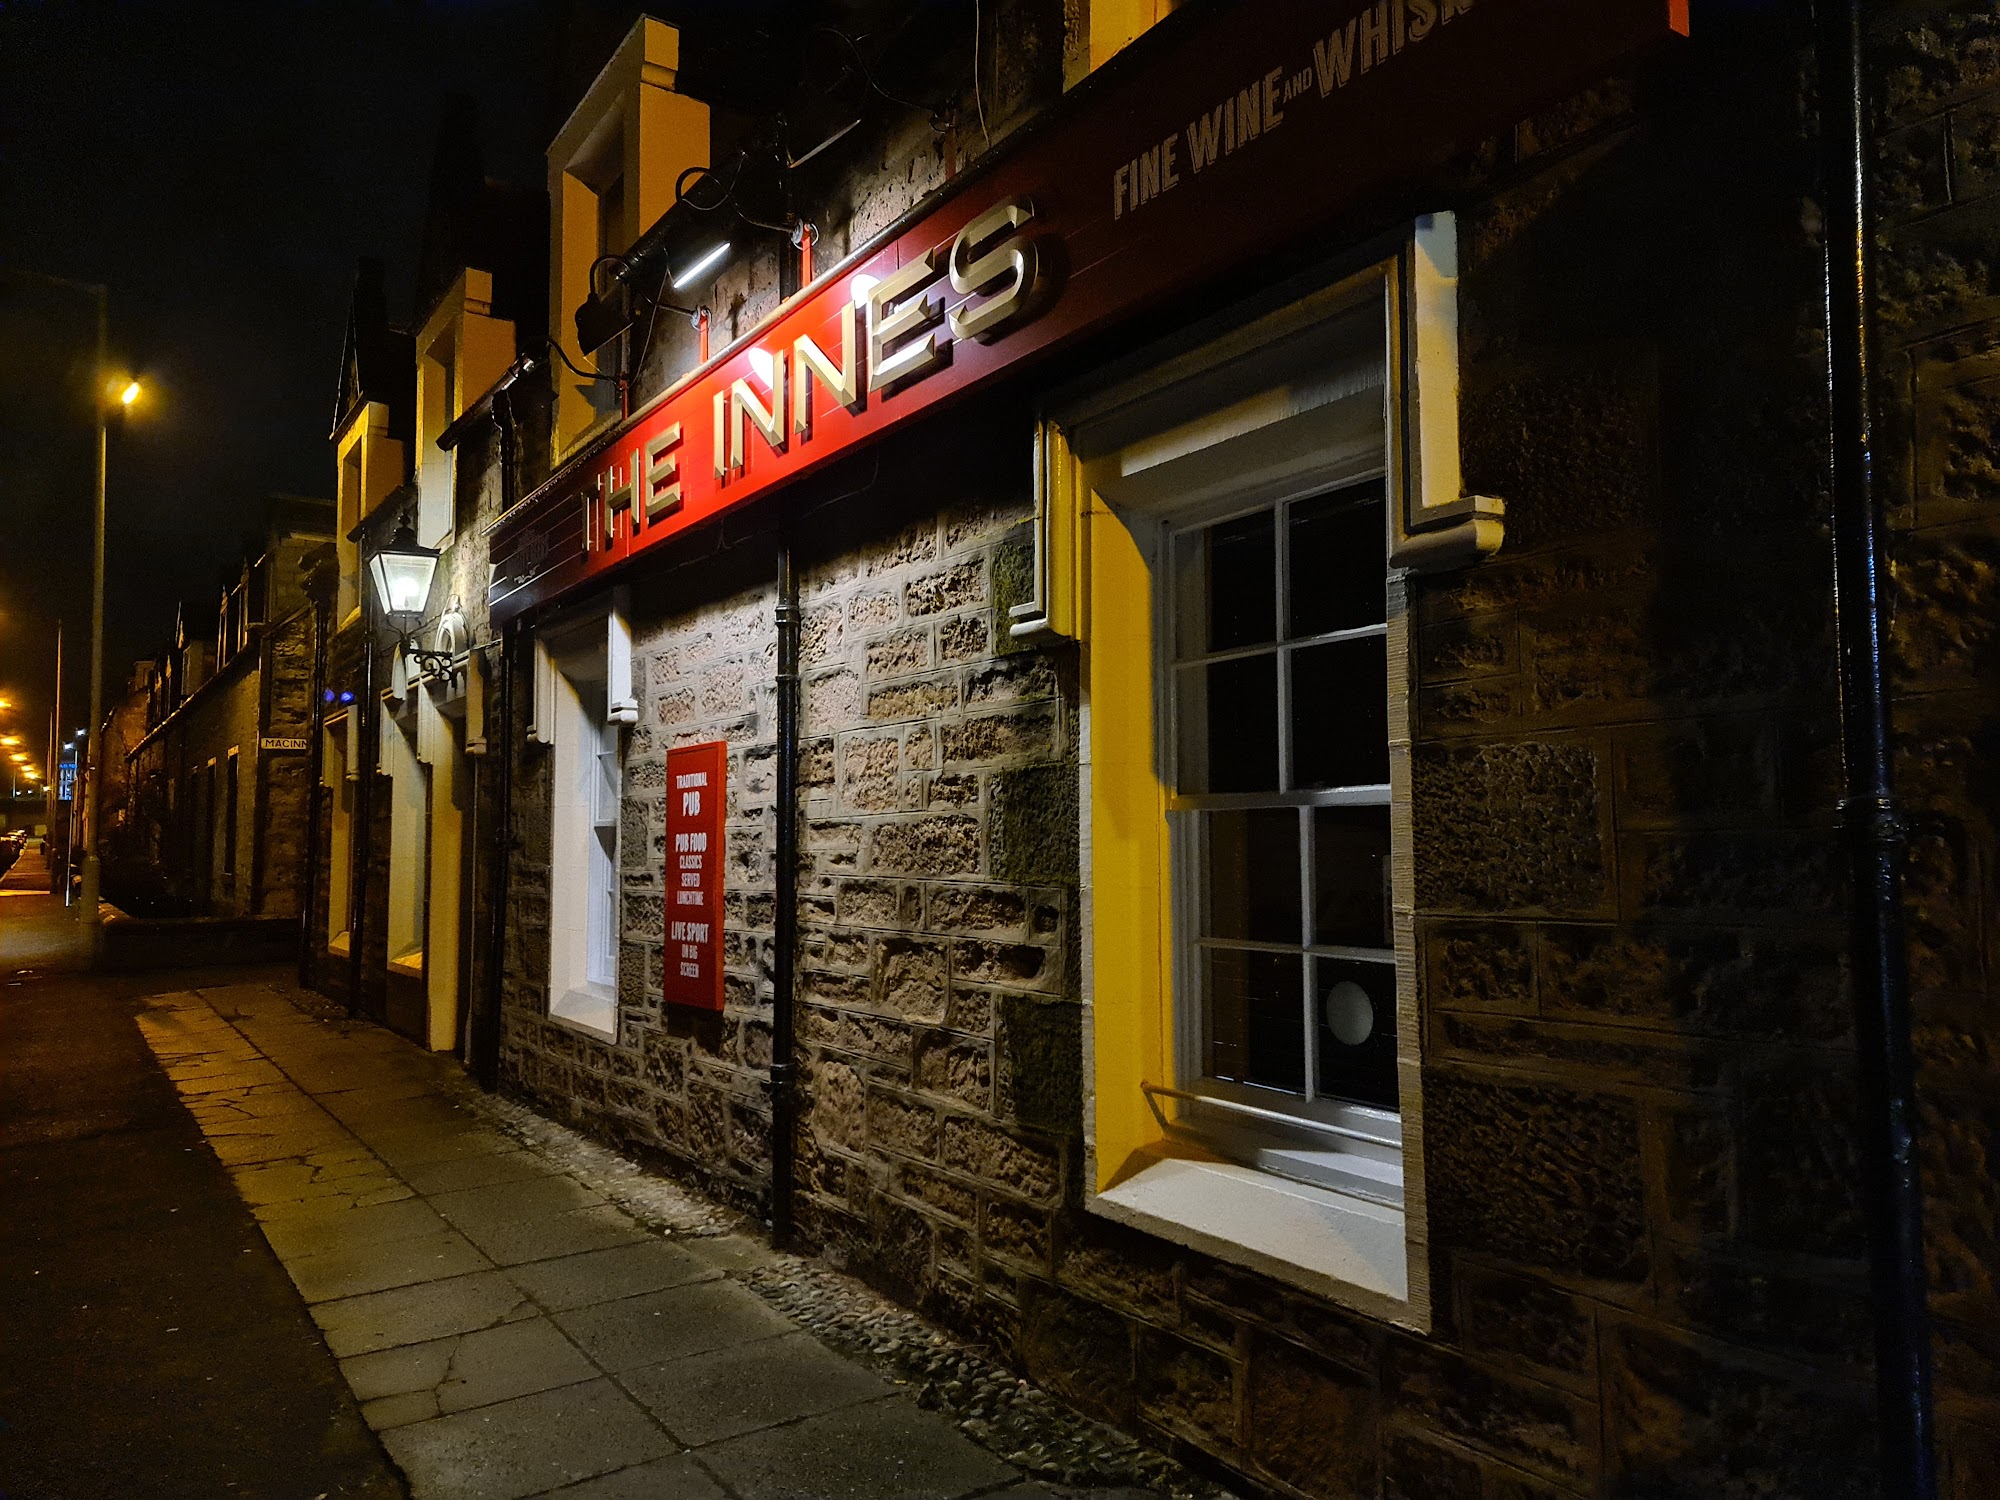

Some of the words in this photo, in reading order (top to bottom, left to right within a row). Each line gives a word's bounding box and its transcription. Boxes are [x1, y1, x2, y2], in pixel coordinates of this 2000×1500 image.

[1113, 132, 1183, 221] FINE
[1187, 64, 1284, 175] WINE
[1284, 66, 1314, 105] AND
[579, 421, 683, 553] THE
[712, 195, 1041, 479] INNES
[682, 790, 701, 817] PUB
[675, 833, 689, 853] PUB
[690, 832, 707, 853] FOOD
[679, 854, 702, 870] CLASSICS
[681, 872, 700, 888] SERVED
[671, 920, 686, 941] LIVE
[687, 922, 709, 944] SPORT
